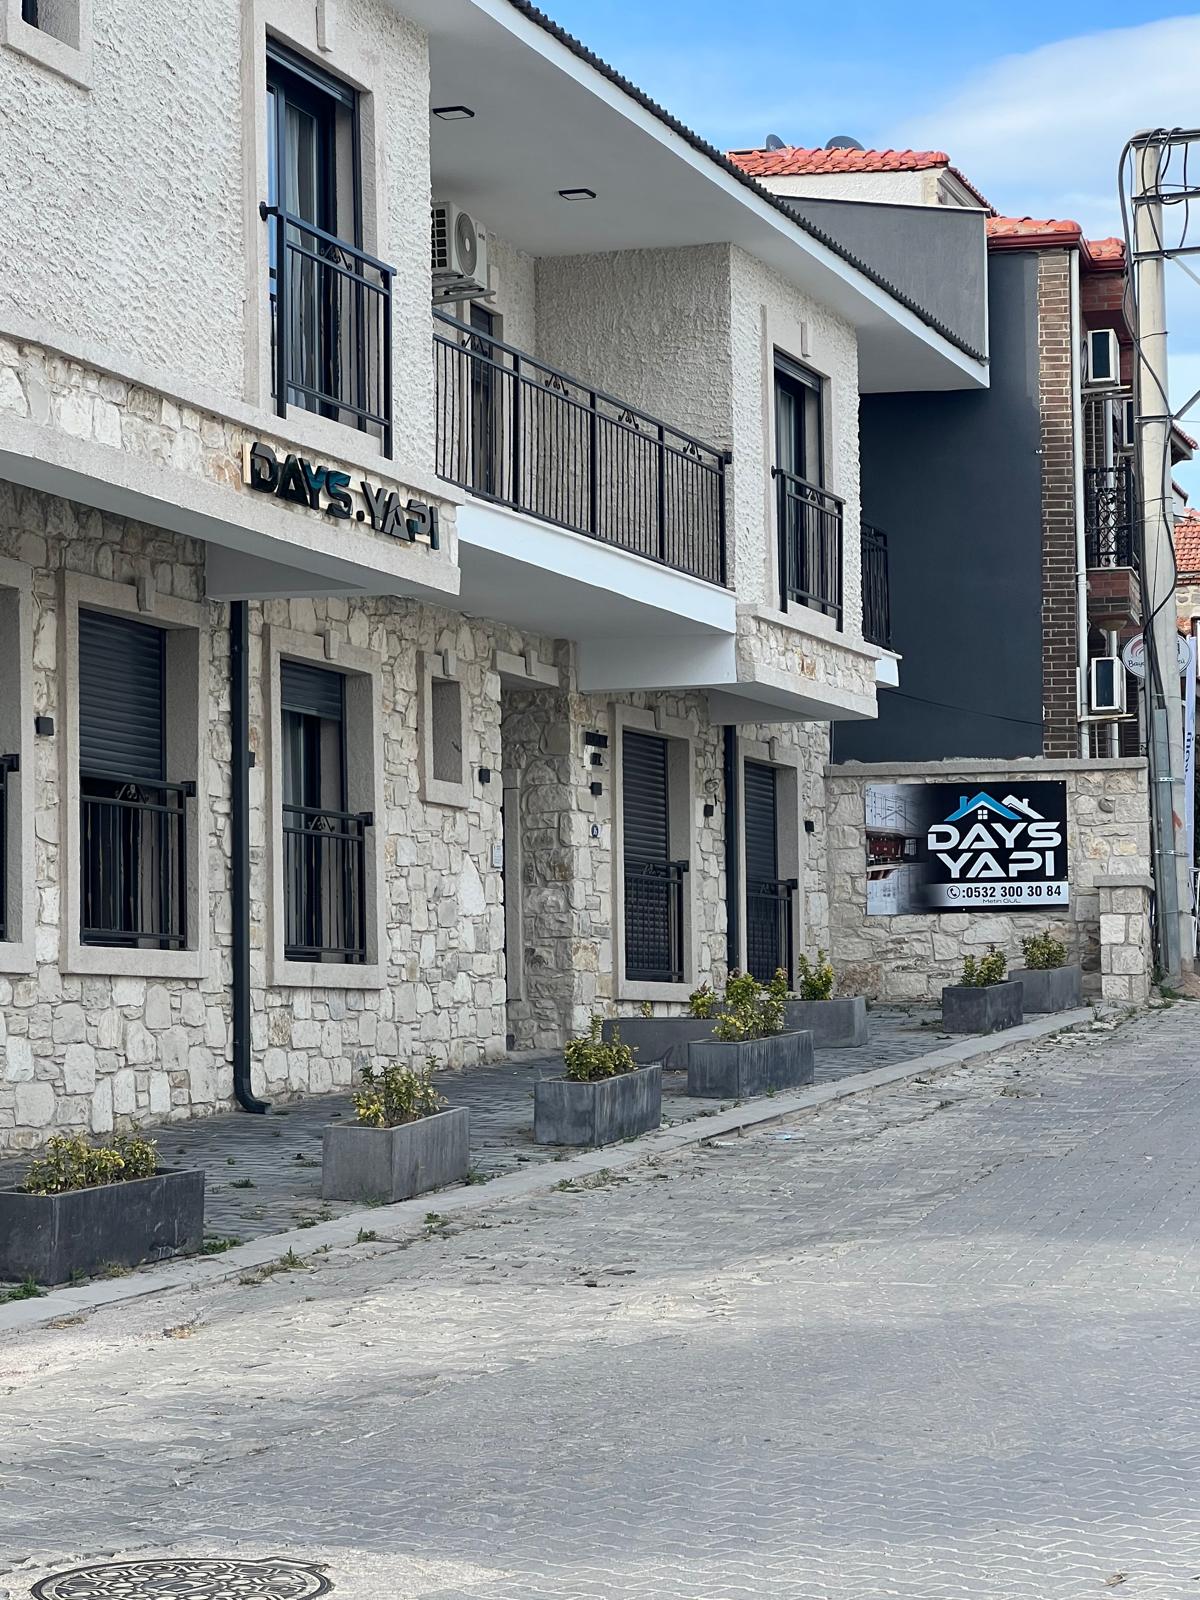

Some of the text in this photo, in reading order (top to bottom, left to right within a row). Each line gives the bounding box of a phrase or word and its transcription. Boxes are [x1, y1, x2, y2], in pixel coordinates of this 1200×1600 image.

[927, 821, 1062, 850] DAYS
[935, 850, 1055, 879] YAPI
[1000, 885, 1023, 897] 300
[1027, 885, 1042, 897] 30
[1046, 885, 1061, 896] 84
